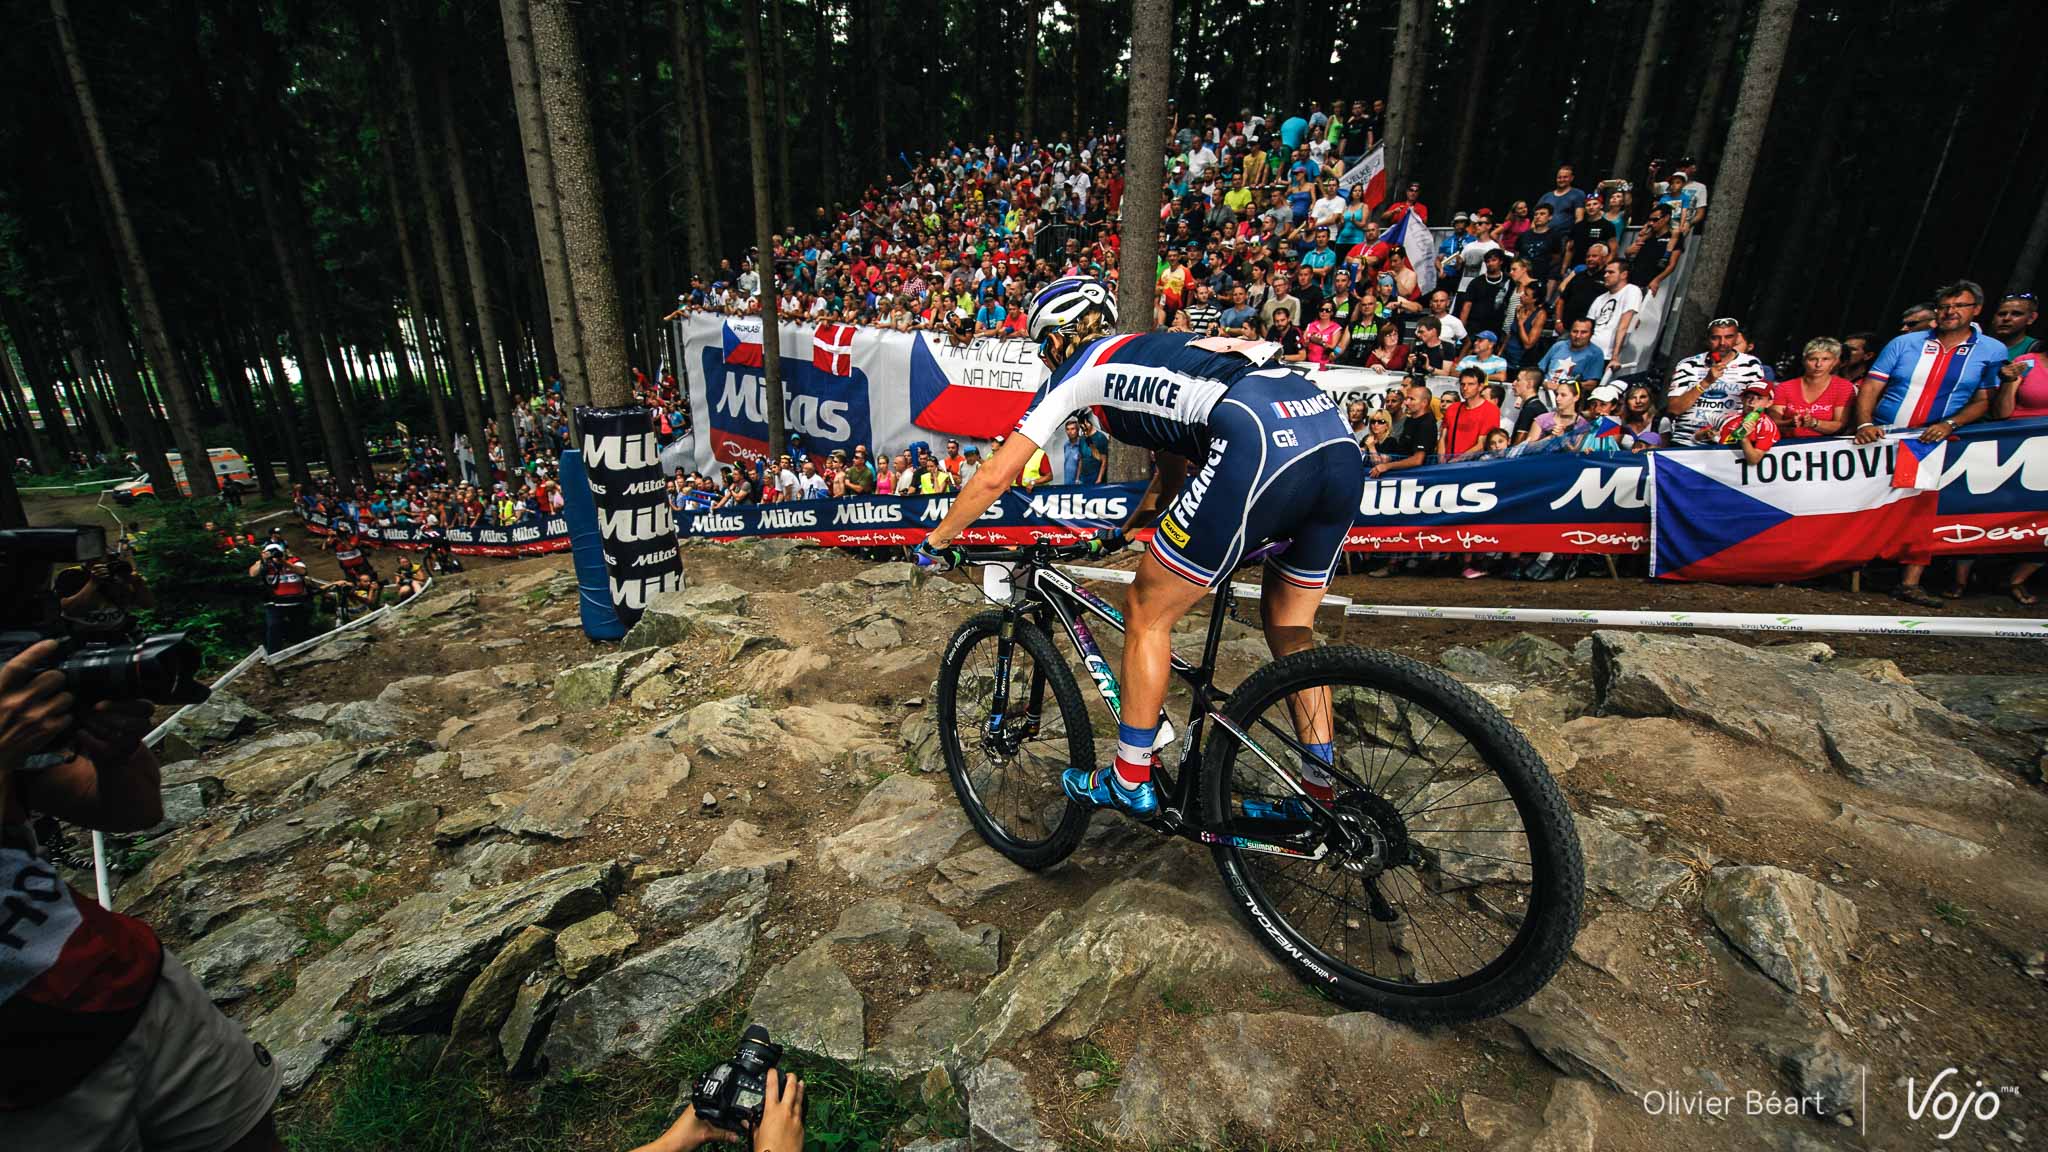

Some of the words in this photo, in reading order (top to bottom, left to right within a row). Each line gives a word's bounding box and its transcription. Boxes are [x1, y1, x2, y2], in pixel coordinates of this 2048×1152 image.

[963, 368, 984, 386] NA
[1103, 372, 1181, 410] FRANCE
[1285, 393, 1335, 418] FRANCE
[622, 477, 666, 496] Mitas
[1174, 437, 1228, 529] FRANCE
[832, 502, 903, 525] Mitas
[1023, 493, 1128, 520] Mitas
[689, 513, 745, 533] Mitas
[757, 507, 817, 530] Mitas
[511, 525, 541, 543] Mitas
[1164, 521, 1182, 540] MAVIC
[1414, 532, 1451, 549] for
[1455, 530, 1499, 549] You
[632, 547, 678, 567] Mitas
[1246, 895, 1304, 959] MEZCAL
